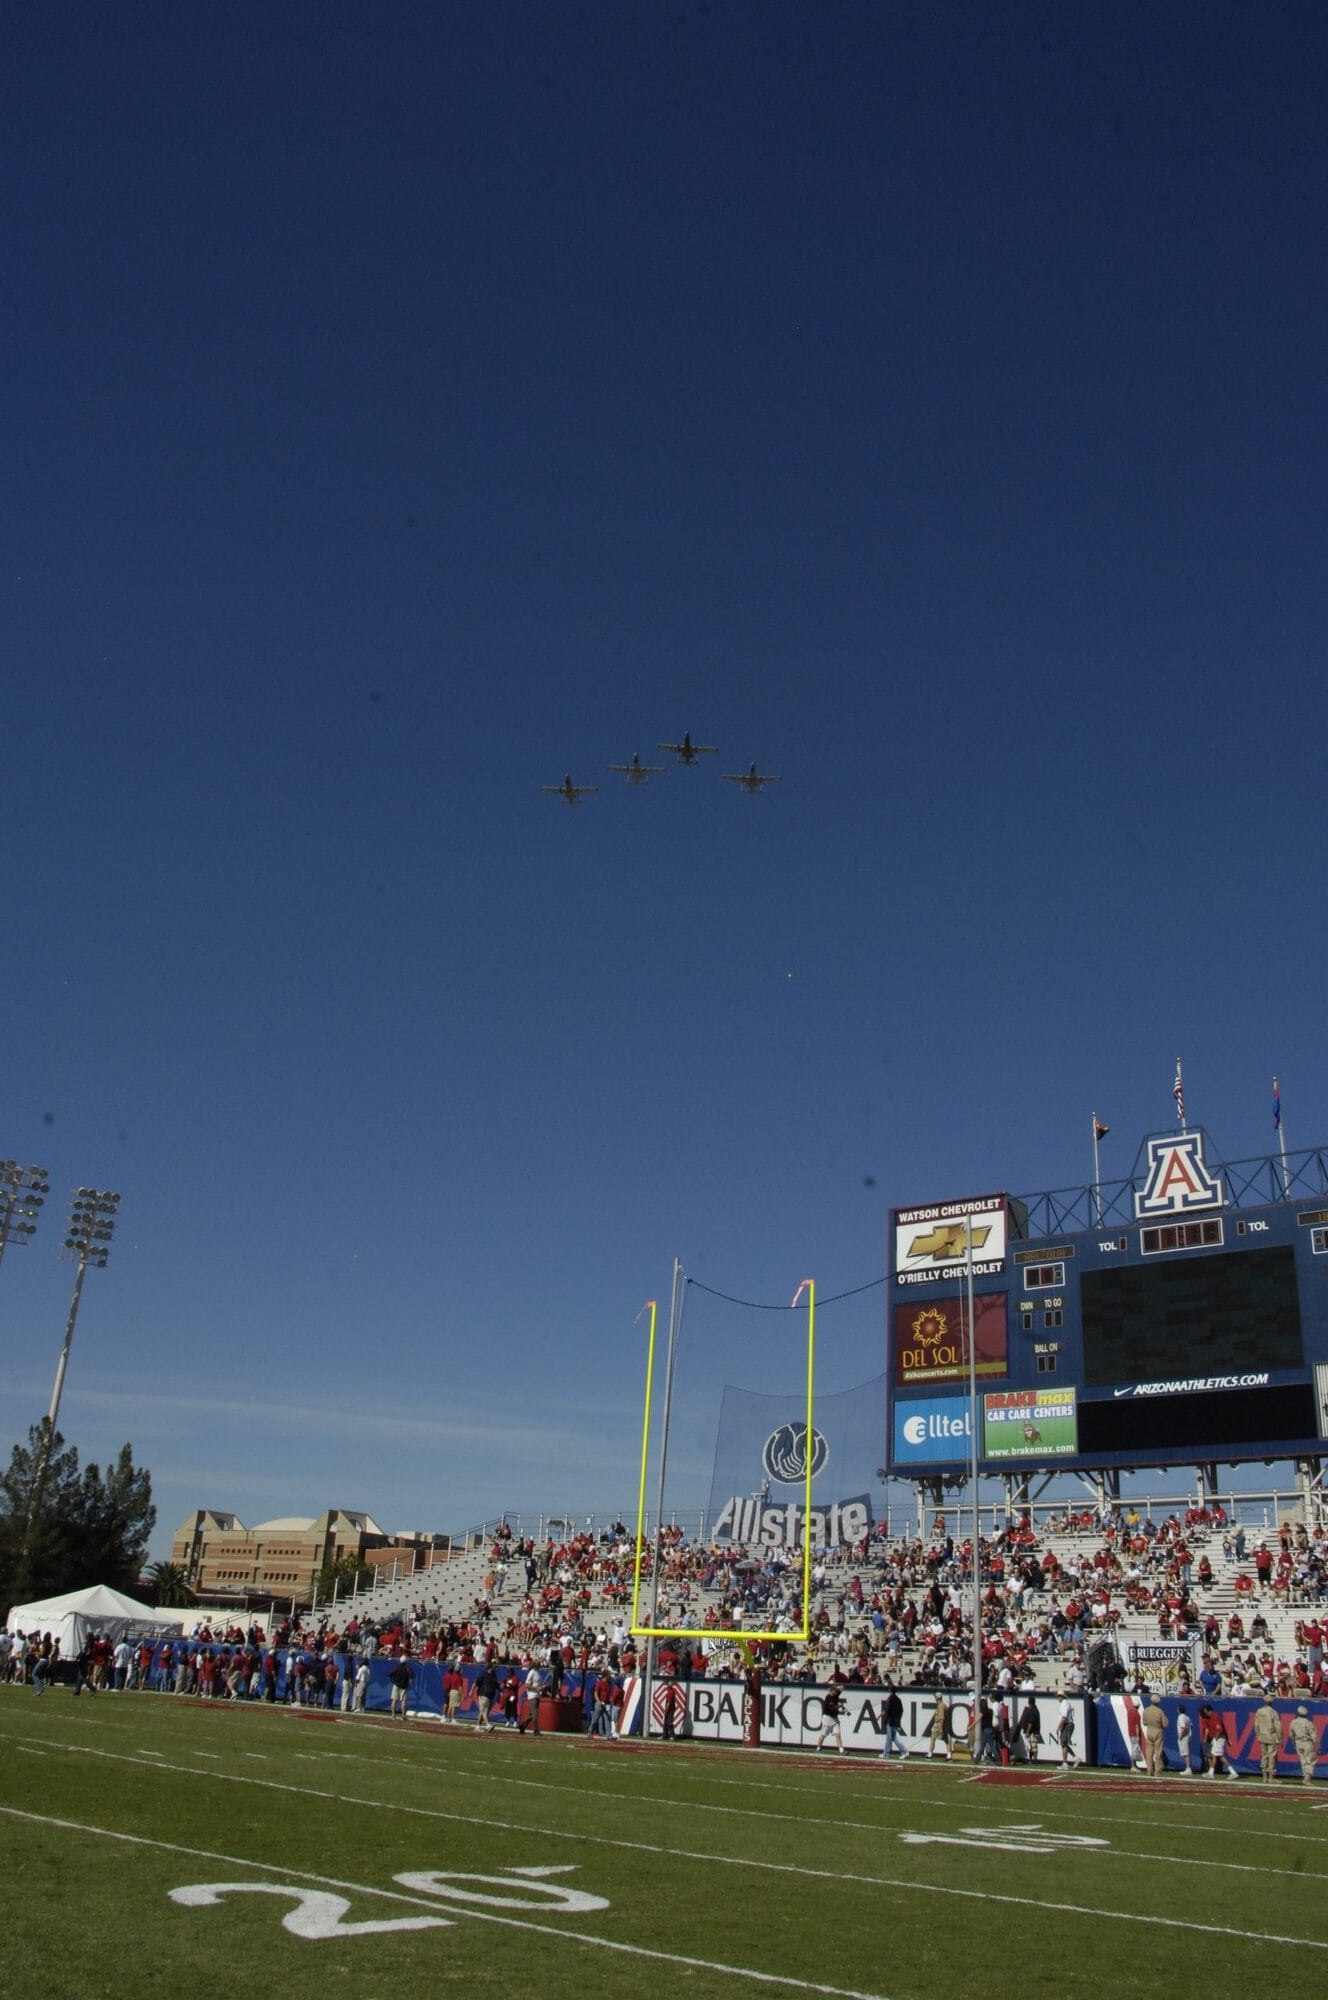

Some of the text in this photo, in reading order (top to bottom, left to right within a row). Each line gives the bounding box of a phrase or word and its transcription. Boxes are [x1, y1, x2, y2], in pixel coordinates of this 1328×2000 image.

[1135, 1134, 1222, 1217] A
[899, 1198, 1001, 1223] WATSON CHEVROLET
[1248, 1221, 1269, 1232] TOL
[1098, 1241, 1118, 1252] TOL
[898, 1262, 1003, 1284] O'RIELLY CHEVROLET
[1044, 1298, 1062, 1308] TO GO
[902, 1346, 959, 1368] DEL SOL
[1035, 1342, 1058, 1353] BALL ON
[1133, 1373, 1269, 1395] ARIZONAATHLETICS.COM
[985, 1391, 1037, 1410] BRAKE
[987, 1406, 1073, 1422] CAR CARE CENTERS
[988, 1444, 1075, 1457] www.brakemax.com
[712, 1496, 869, 1549] Allstate
[167, 1870, 610, 1939] 20
